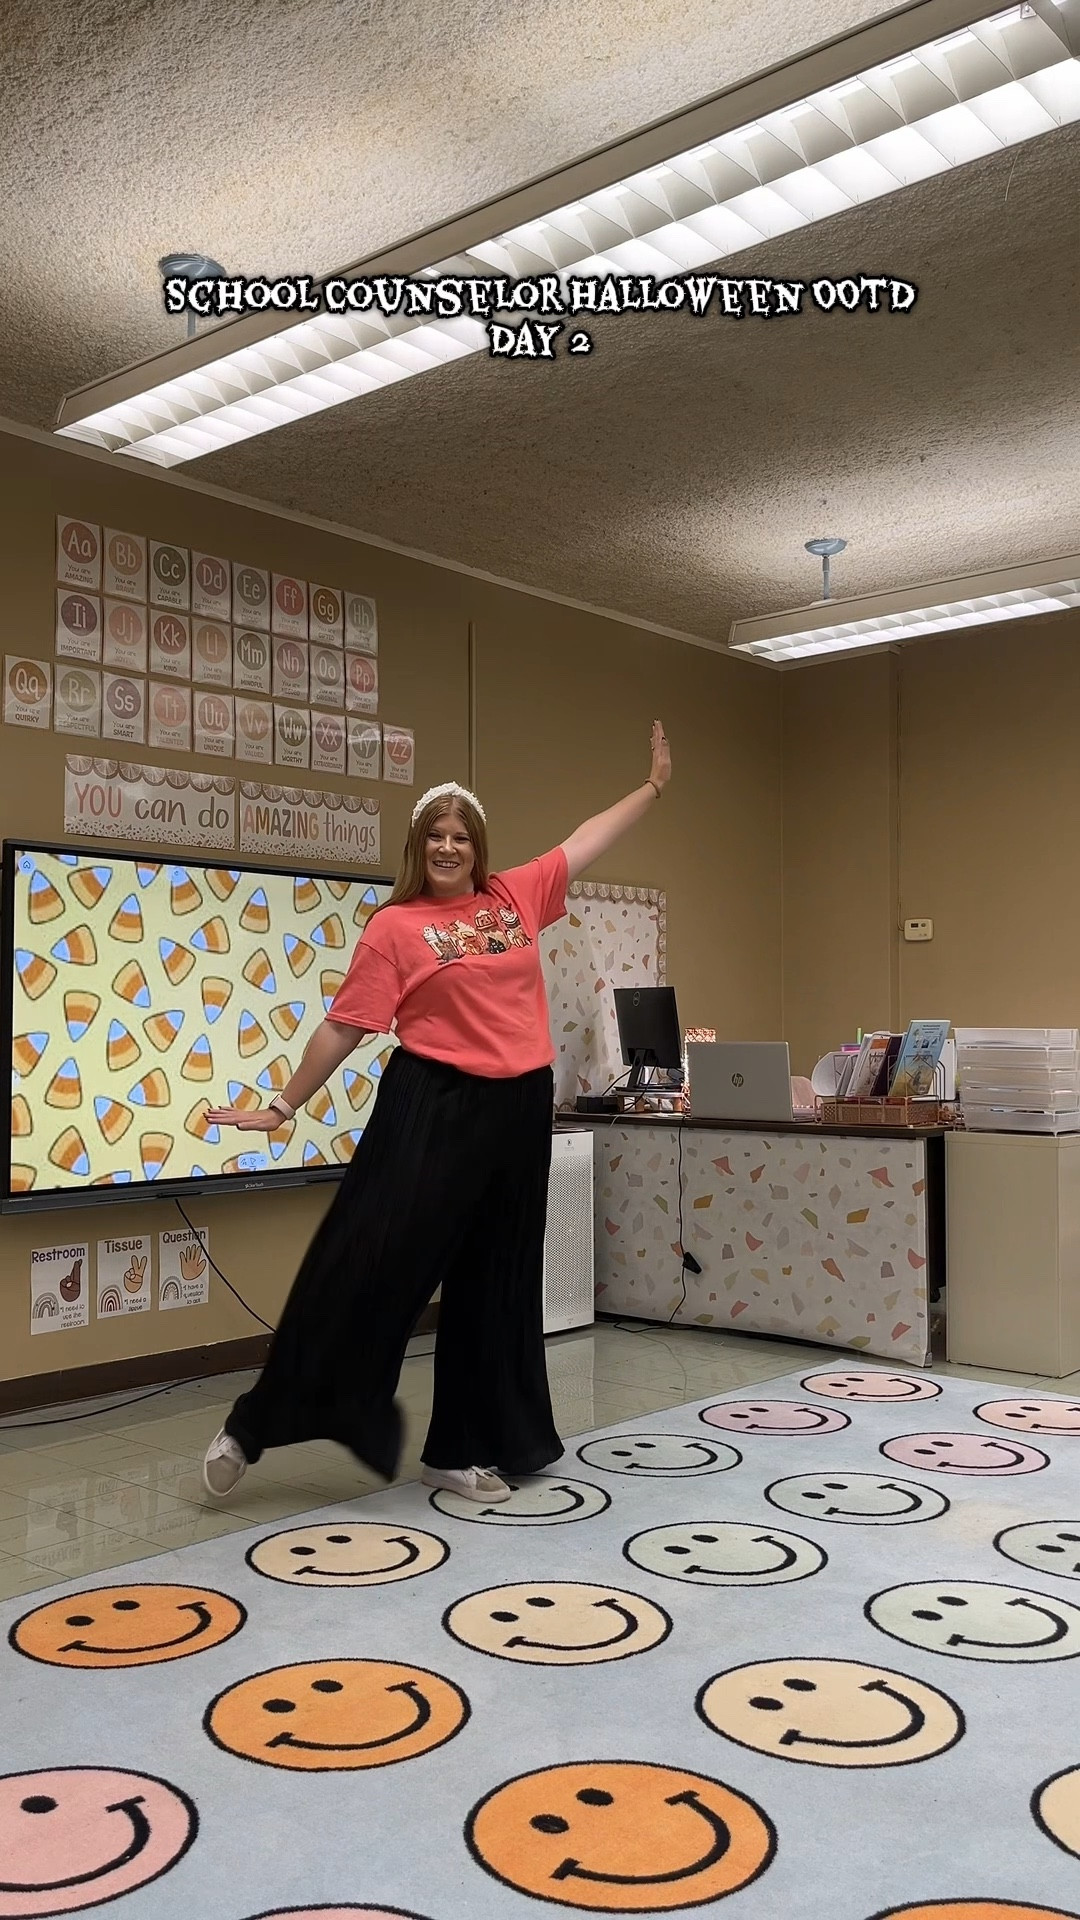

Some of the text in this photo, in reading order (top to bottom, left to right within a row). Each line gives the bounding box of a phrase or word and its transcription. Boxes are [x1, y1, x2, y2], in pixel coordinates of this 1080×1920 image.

[68, 529, 92, 558] Aa
[115, 541, 136, 568] Bb
[64, 572, 93, 584] AMAZING
[67, 563, 80, 573] You
[159, 553, 180, 579] Cc
[202, 563, 222, 590] Dd
[114, 576, 126, 584] You
[242, 574, 260, 600] Ee
[157, 594, 182, 605] CAPABLE
[283, 585, 298, 609] Ff
[318, 595, 334, 623] Gg
[72, 602, 86, 629] Ii
[353, 604, 369, 625] Hh
[117, 613, 133, 643] Jj
[160, 621, 180, 648] Kk
[60, 644, 97, 657] IMPORTANT
[67, 637, 79, 645] You
[240, 639, 263, 665] Mm
[163, 664, 178, 673] KIND
[282, 648, 299, 673] Nn
[319, 656, 336, 680] Oo
[15, 668, 40, 700] Qq
[203, 672, 221, 680] LOVED
[240, 679, 264, 689] MINDFUL
[355, 664, 370, 692] Pp
[68, 678, 90, 704] Rr
[114, 685, 134, 712] Ss
[15, 713, 40, 723] QUIRKY
[162, 694, 179, 720] Tt
[204, 702, 224, 729] Uu
[58, 720, 96, 733] SPECTFUL
[112, 720, 124, 728] You
[113, 728, 134, 738] SMART
[245, 709, 263, 734] Vv
[283, 716, 303, 741] Ww
[320, 722, 338, 746] Xx
[203, 744, 224, 753] UNIQUE
[281, 755, 303, 764] WORTHY
[74, 782, 230, 829] YOU can do
[243, 804, 376, 853] AMAZING things
[732, 1073, 743, 1087] hp
[31, 1247, 85, 1264] Restroom
[104, 1239, 143, 1253] Tissue
[65, 1304, 78, 1312] need
